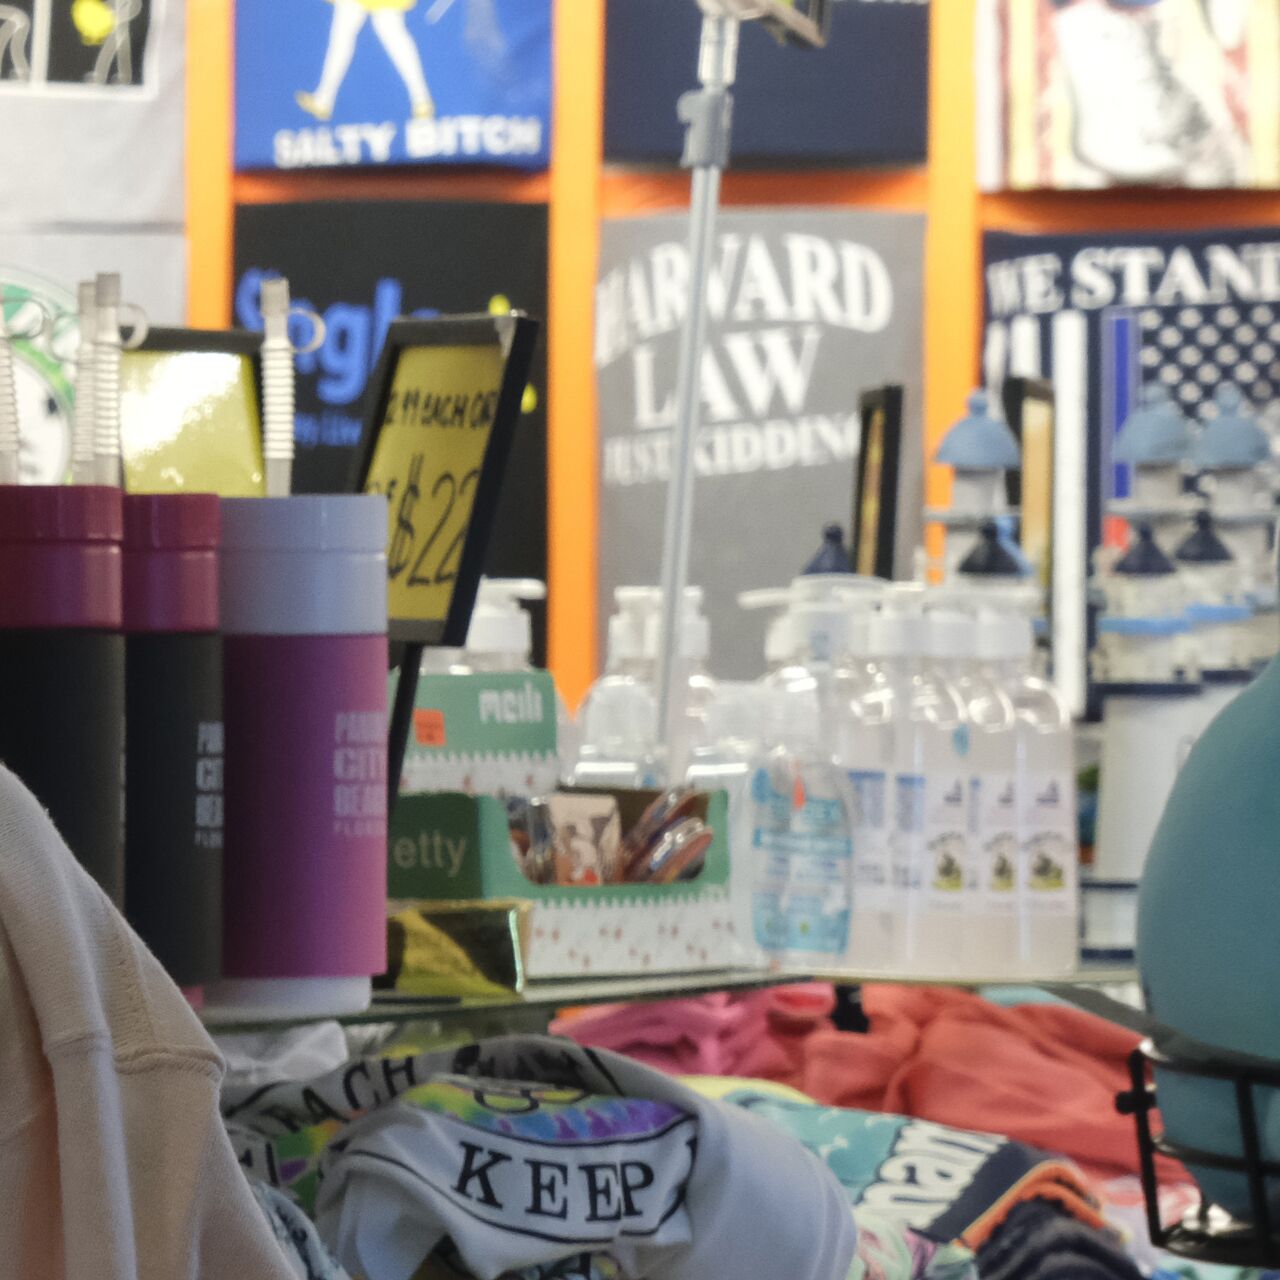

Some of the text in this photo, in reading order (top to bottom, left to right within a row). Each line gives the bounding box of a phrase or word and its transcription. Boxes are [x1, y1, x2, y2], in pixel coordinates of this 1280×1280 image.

[273, 114, 542, 168] SALTY BITCH
[986, 252, 1064, 316] WE
[634, 325, 824, 430] LAW
[692, 410, 860, 477] KIDDIN
[450, 1140, 656, 1223] KEEP
